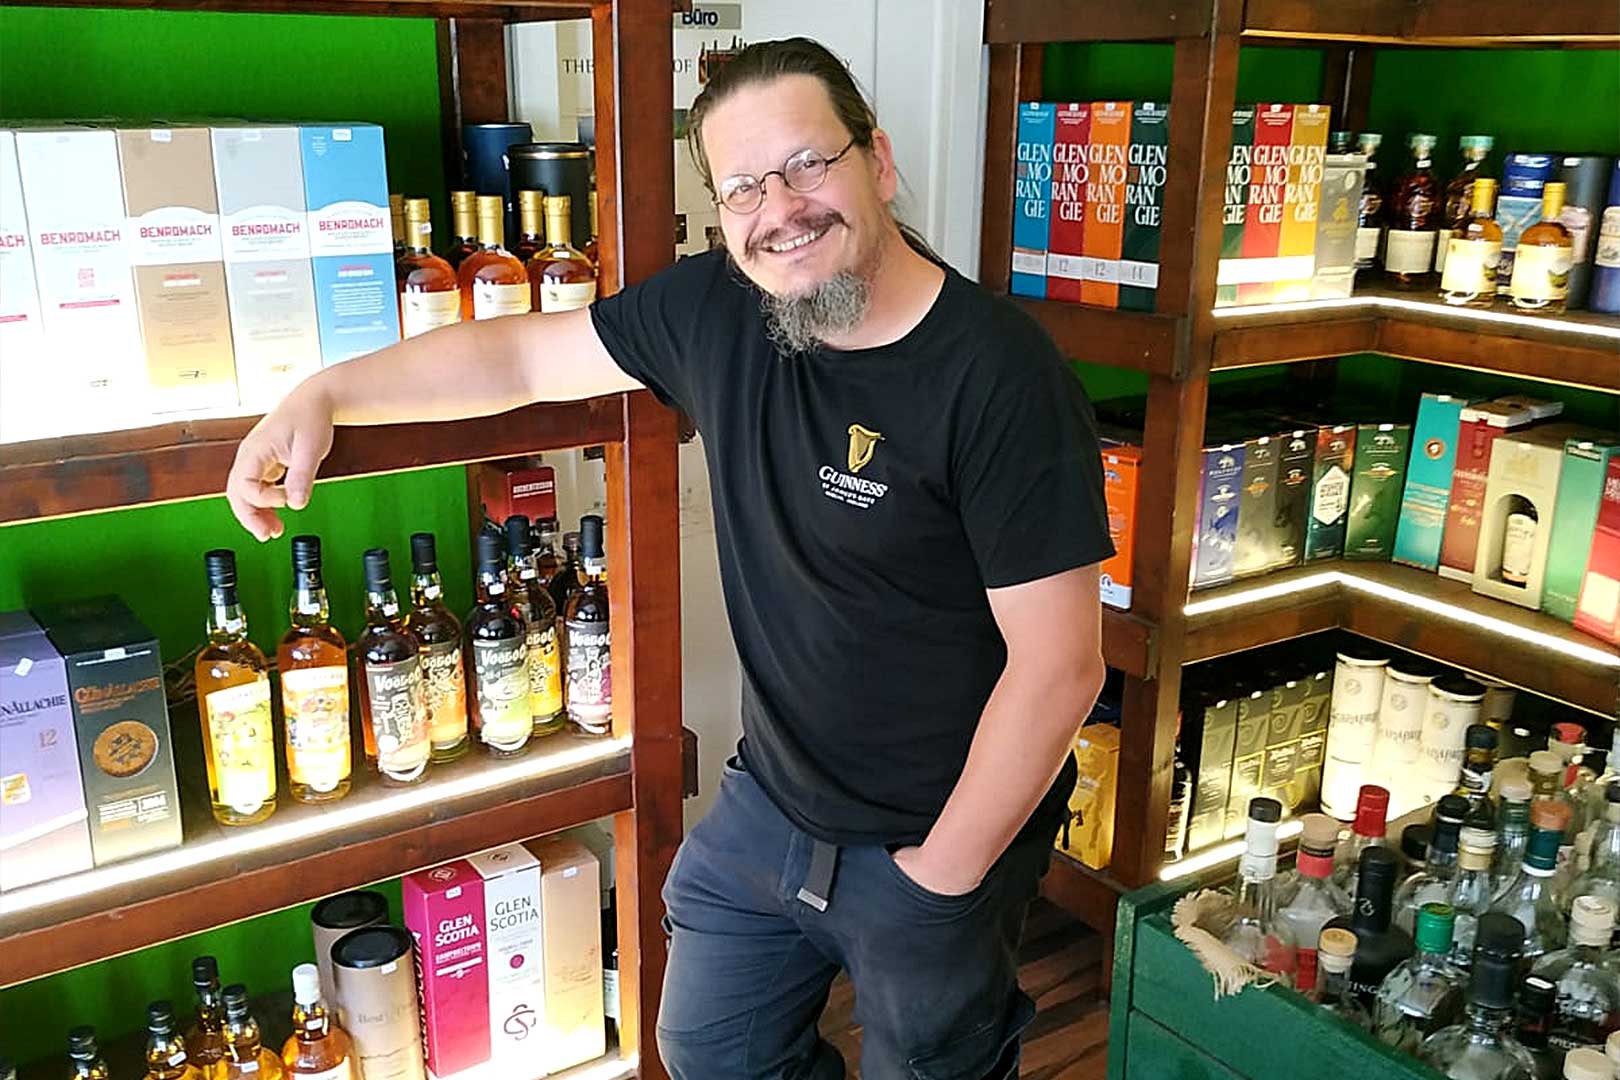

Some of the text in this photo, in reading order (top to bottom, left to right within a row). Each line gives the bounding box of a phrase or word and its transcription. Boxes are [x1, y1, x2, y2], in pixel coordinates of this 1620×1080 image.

[562, 58, 594, 74] THE
[1017, 143, 1050, 162] GLEN
[1053, 143, 1089, 163] GLEN
[1089, 144, 1126, 164] GLEN
[1128, 144, 1167, 165] GLEN
[1229, 145, 1252, 165] EN
[1254, 145, 1290, 165] GLEN
[1289, 145, 1325, 165] GLEN
[1027, 162, 1051, 181] MO
[1063, 163, 1088, 184] MO
[1100, 165, 1127, 185] MO
[1139, 165, 1167, 186] MO
[1226, 165, 1250, 185] MO
[1264, 165, 1288, 185] MO
[1299, 165, 1323, 185] MO
[1016, 180, 1042, 199] RAN
[1052, 182, 1079, 202] RAN
[1087, 183, 1116, 203] RAN
[1125, 185, 1156, 205] RAN
[1249, 185, 1280, 204] RAN
[1284, 185, 1316, 204] RAN
[1024, 200, 1046, 218] GIE
[1060, 202, 1083, 221] GIE
[1097, 204, 1120, 223] GIE
[1134, 206, 1160, 226] GIE
[1259, 204, 1283, 223] GIE
[1295, 205, 1318, 222] GIE
[140, 225, 212, 238] BENROMACH
[232, 223, 300, 236] BENROMACH
[319, 218, 384, 231] BENROMACH
[41, 230, 121, 246] BENROMACH
[1058, 258, 1069, 272] 12
[1095, 262, 1106, 276] 12
[819, 465, 888, 498] GUINNESS
[526, 626, 555, 646] ODOO
[40, 729, 58, 749] 12
[495, 896, 531, 915] GLEN
[439, 913, 473, 933] GLEN
[490, 908, 539, 932] SCOTIA
[435, 924, 480, 947] SCOTIA
